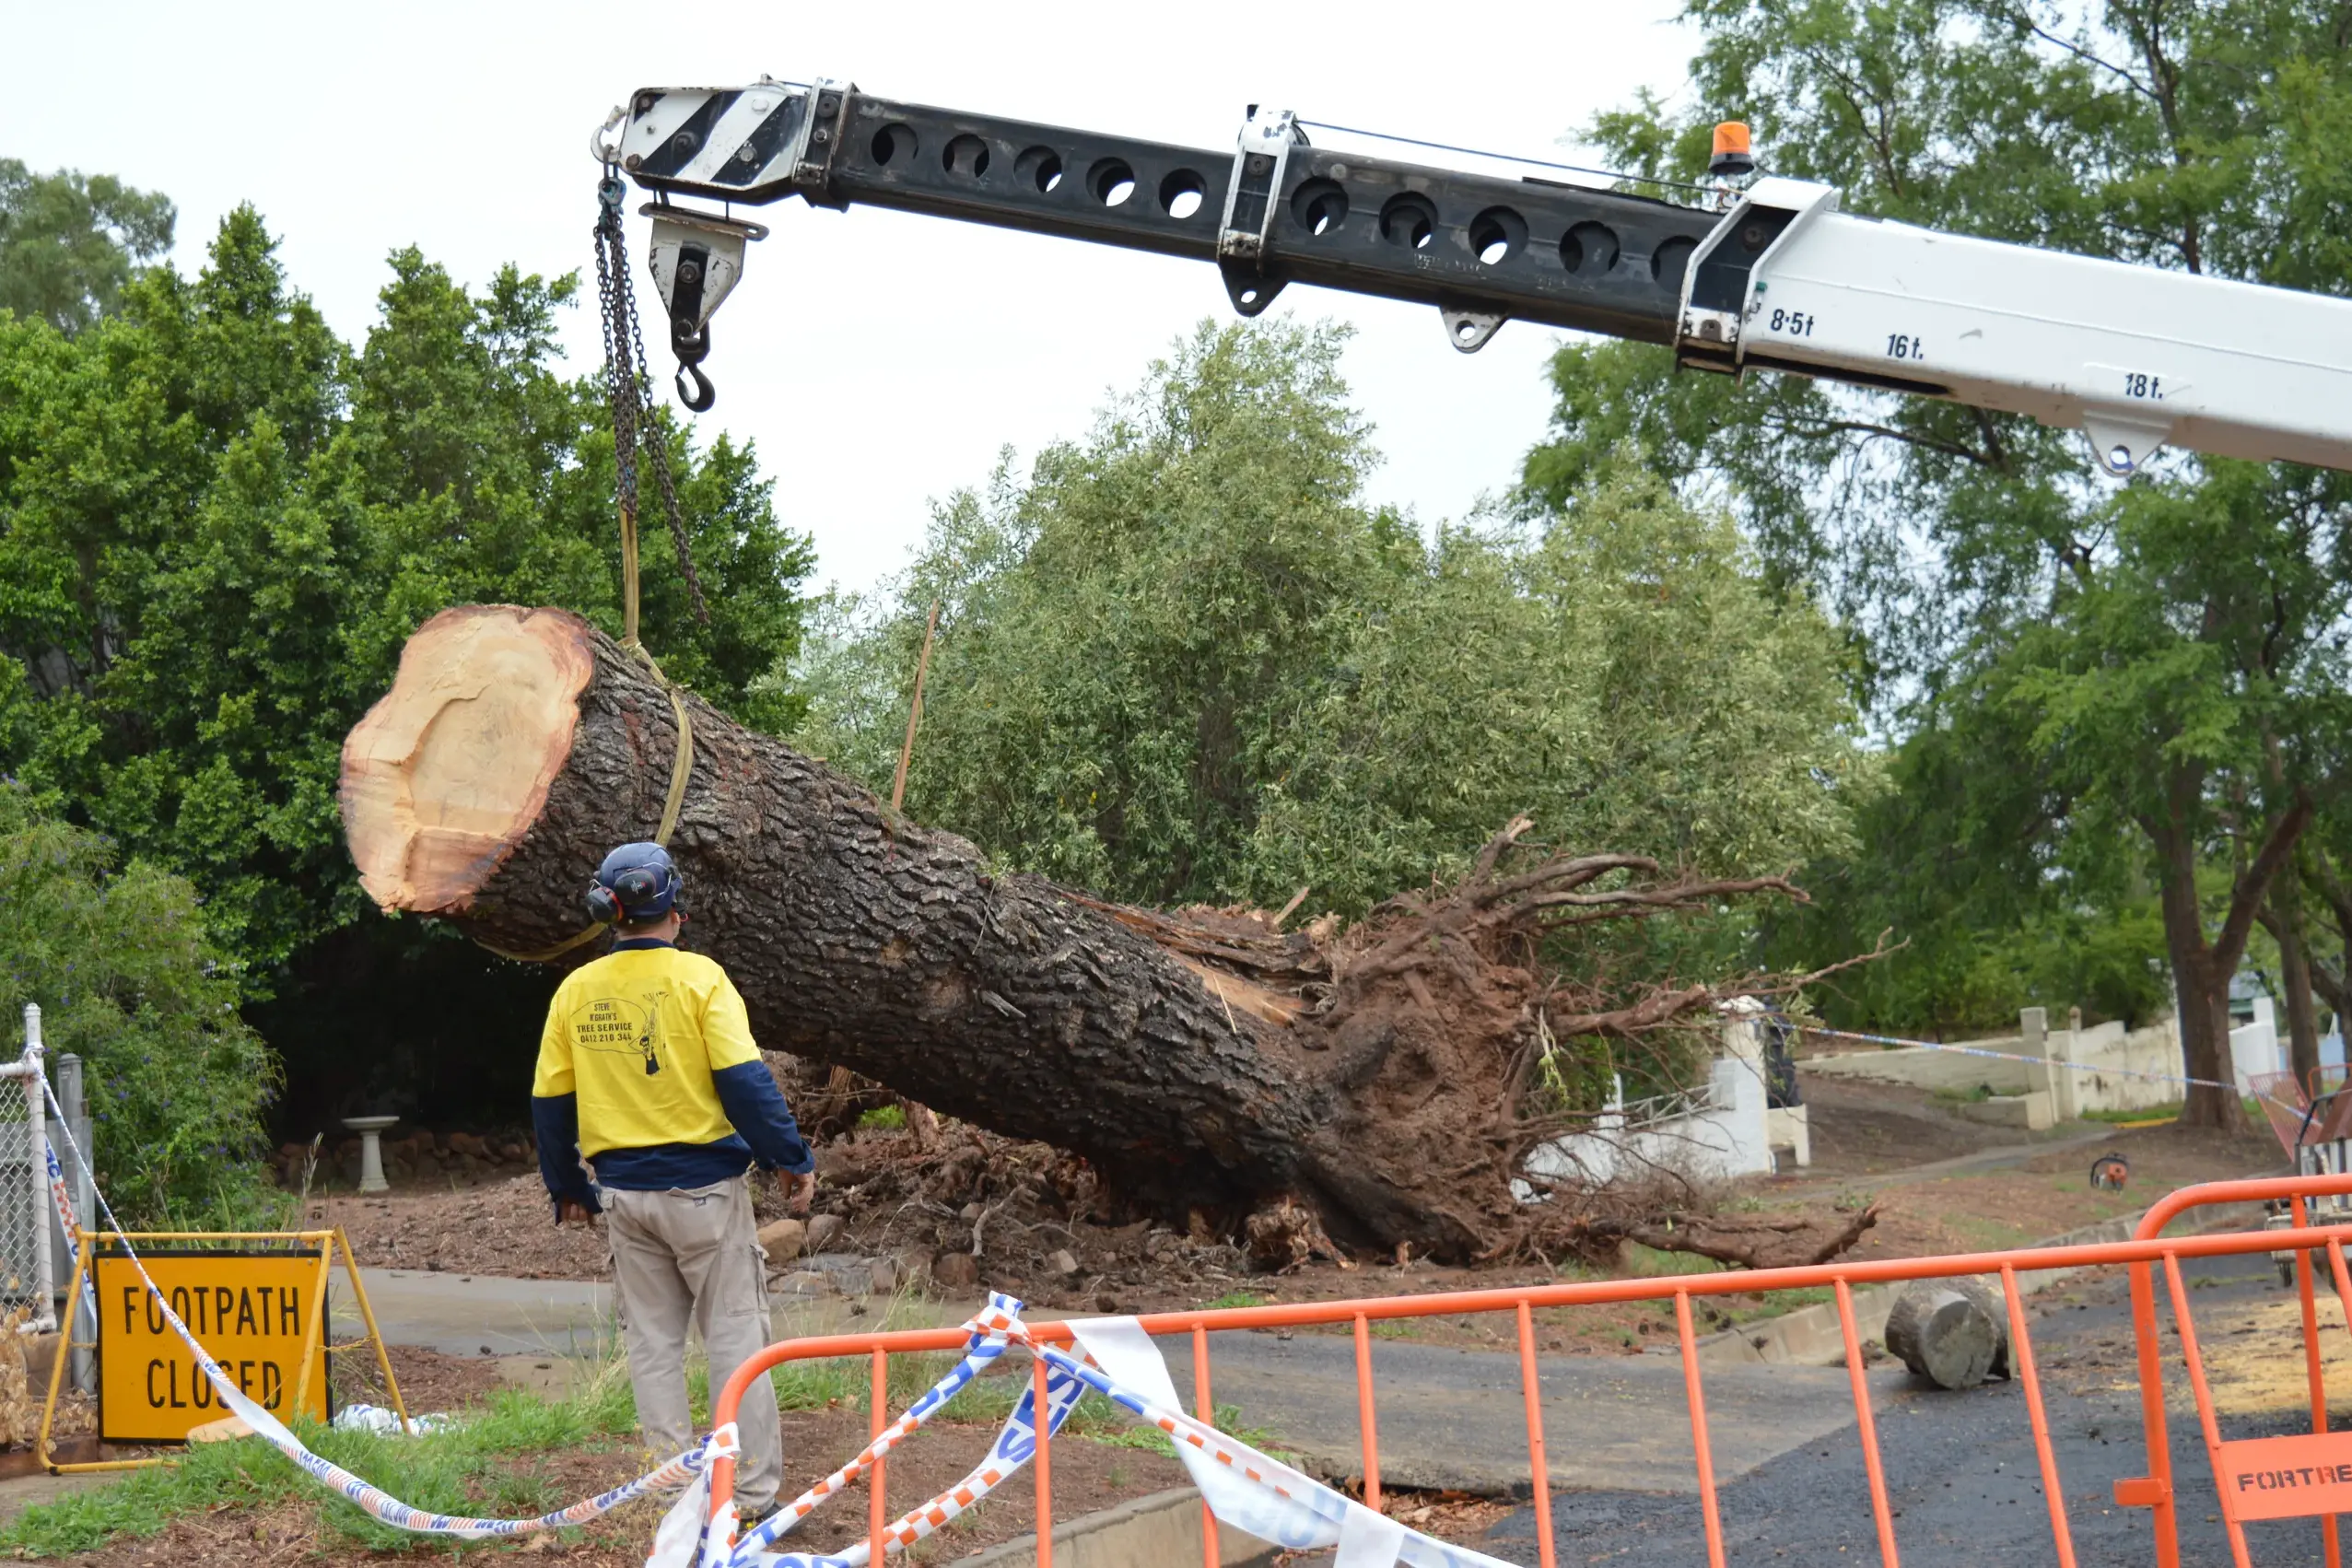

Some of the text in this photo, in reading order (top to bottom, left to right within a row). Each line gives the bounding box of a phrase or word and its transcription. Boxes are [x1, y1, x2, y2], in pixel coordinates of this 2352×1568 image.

[593, 1002, 610, 1012] STEVE
[577, 1023, 632, 1033] TREE SERVICE
[580, 1033, 632, 1043] 0412 210 344
[123, 1286, 300, 1336] FOOTPATH
